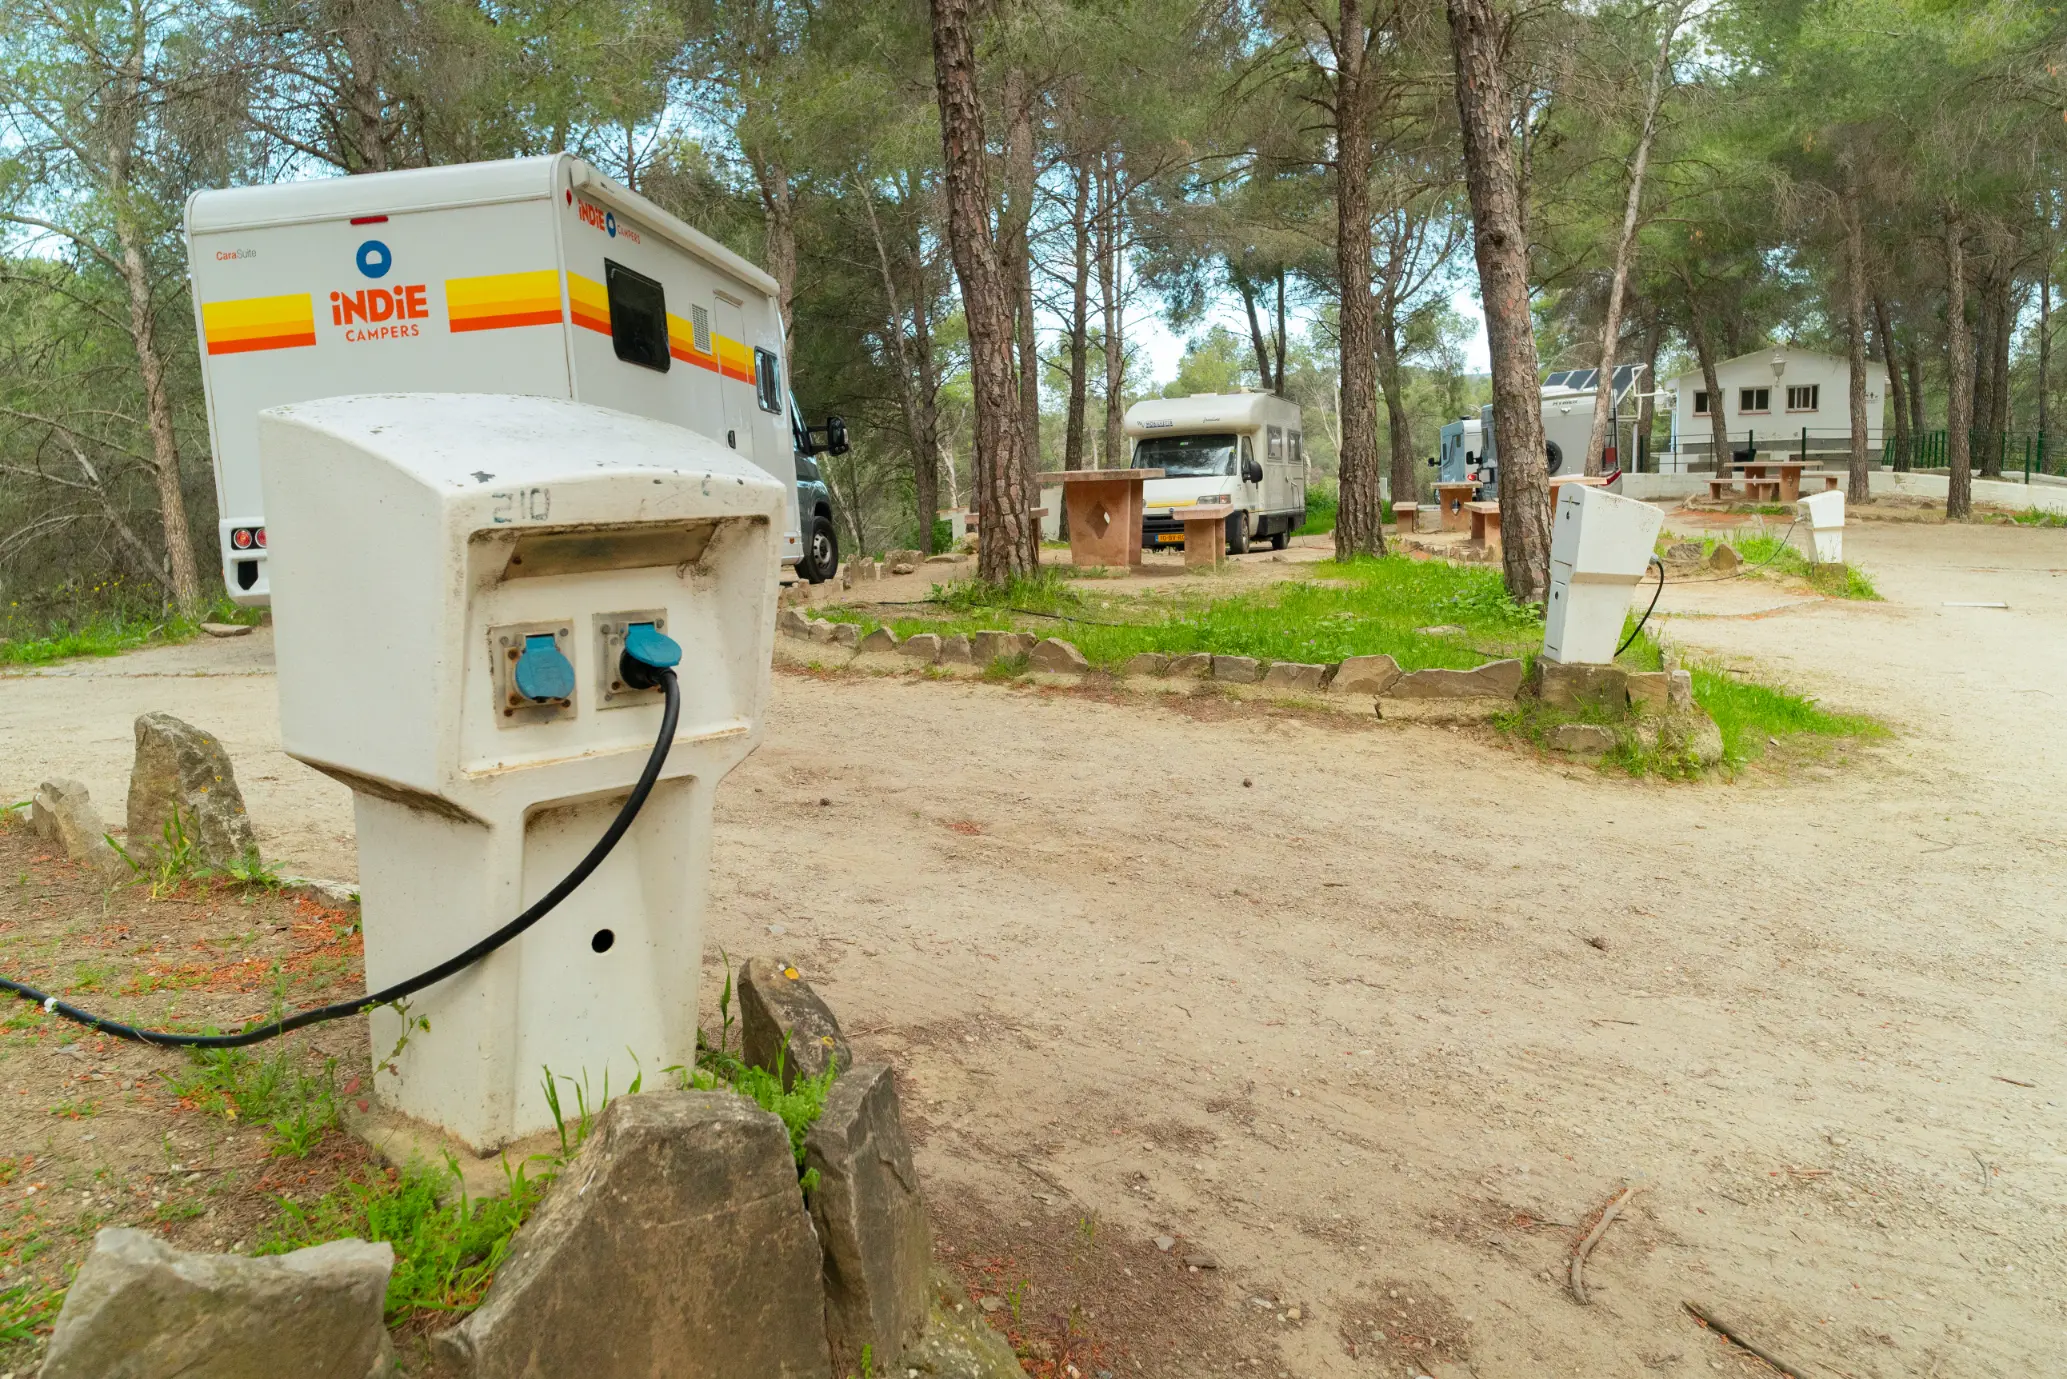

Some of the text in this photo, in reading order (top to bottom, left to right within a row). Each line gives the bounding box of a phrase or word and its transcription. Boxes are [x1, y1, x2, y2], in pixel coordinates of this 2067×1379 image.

[616, 224, 641, 245] CAMPERS
[216, 248, 257, 261] CaraSuite
[345, 323, 420, 342] CAMPERS
